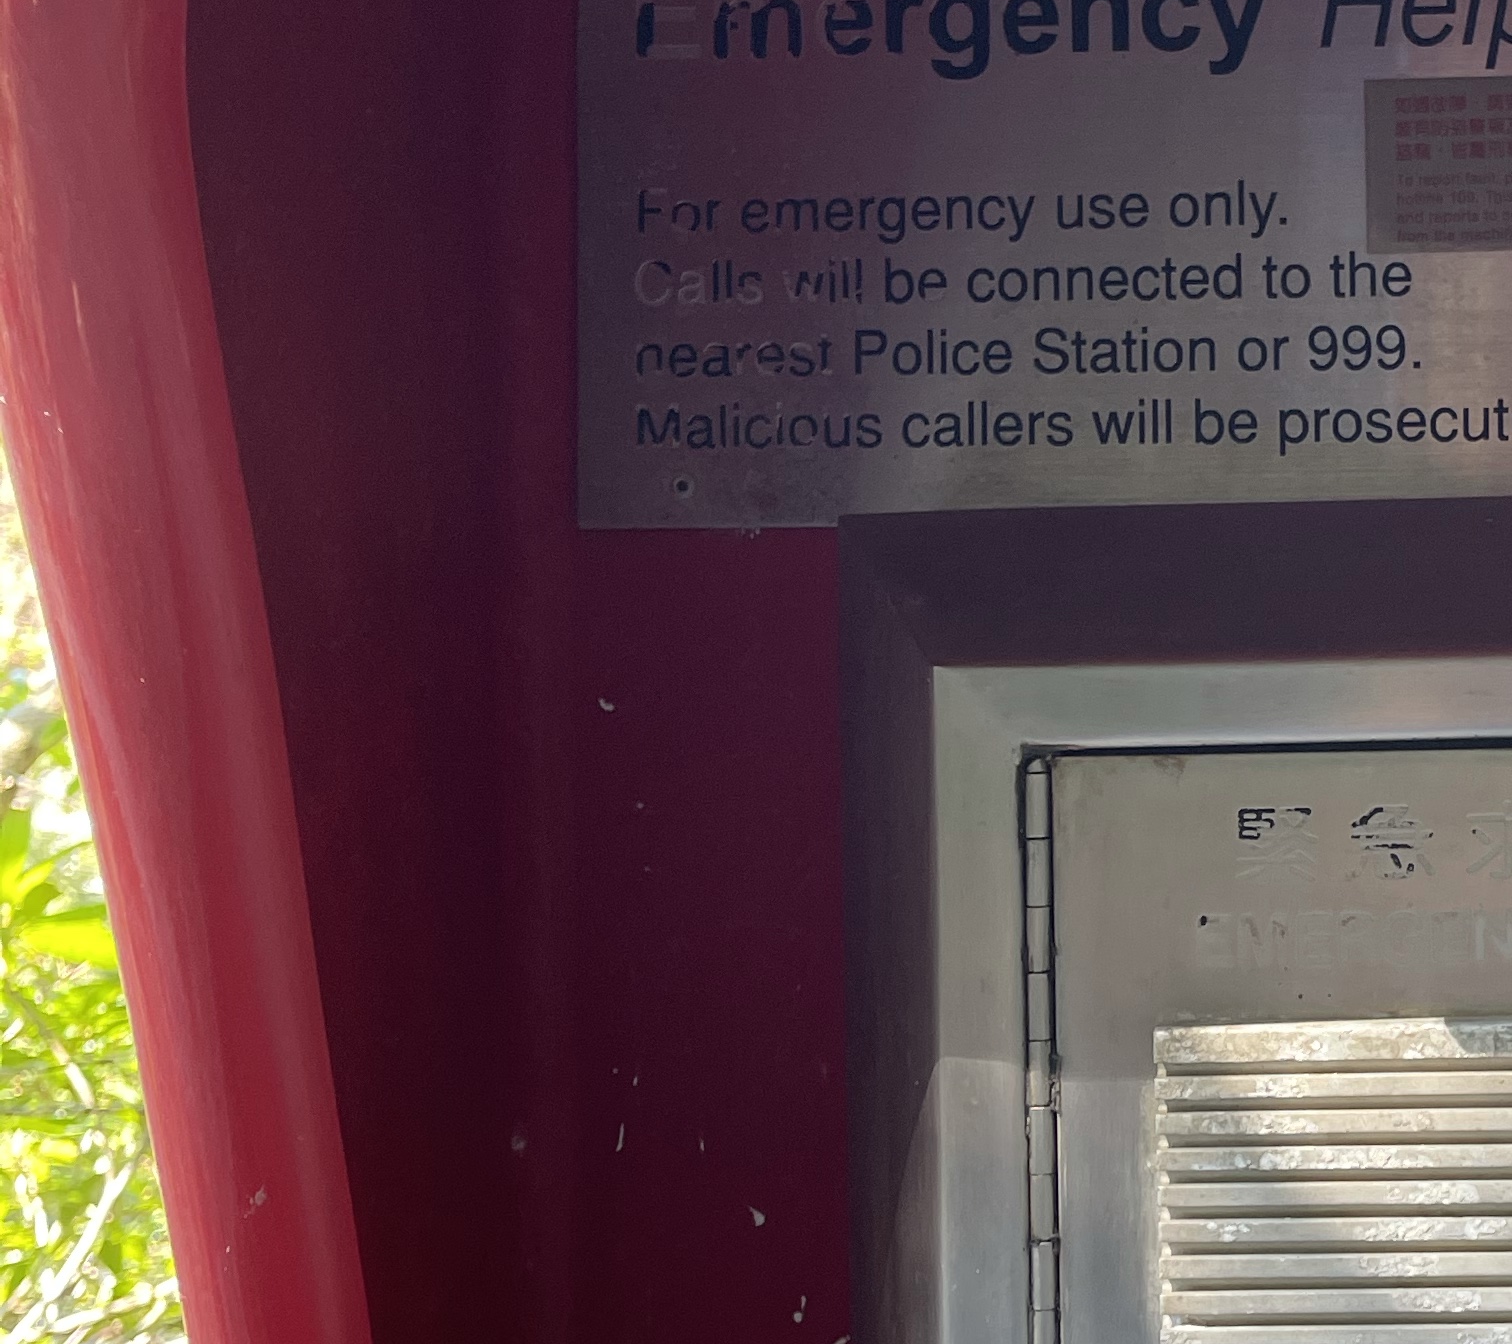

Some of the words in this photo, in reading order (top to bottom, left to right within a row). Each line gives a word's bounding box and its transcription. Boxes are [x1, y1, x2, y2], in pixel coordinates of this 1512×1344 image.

[637, 187, 721, 234] For
[741, 193, 1033, 244] emergency
[1055, 189, 1149, 231] use
[1168, 179, 1289, 241] only.
[634, 259, 763, 307] Calls
[782, 258, 862, 304] will
[885, 258, 947, 304] be
[966, 252, 1242, 304] connected
[1263, 254, 1312, 300] to
[1331, 250, 1412, 298] the
[636, 334, 833, 378] nearest
[855, 328, 1012, 376] Police
[1033, 326, 1217, 375] Station
[1237, 338, 1288, 372] or
[1308, 324, 1422, 372] 999.
[635, 403, 882, 450] Malicious
[902, 400, 1073, 448] callers
[1092, 397, 1173, 445] will
[1193, 397, 1258, 444] be
